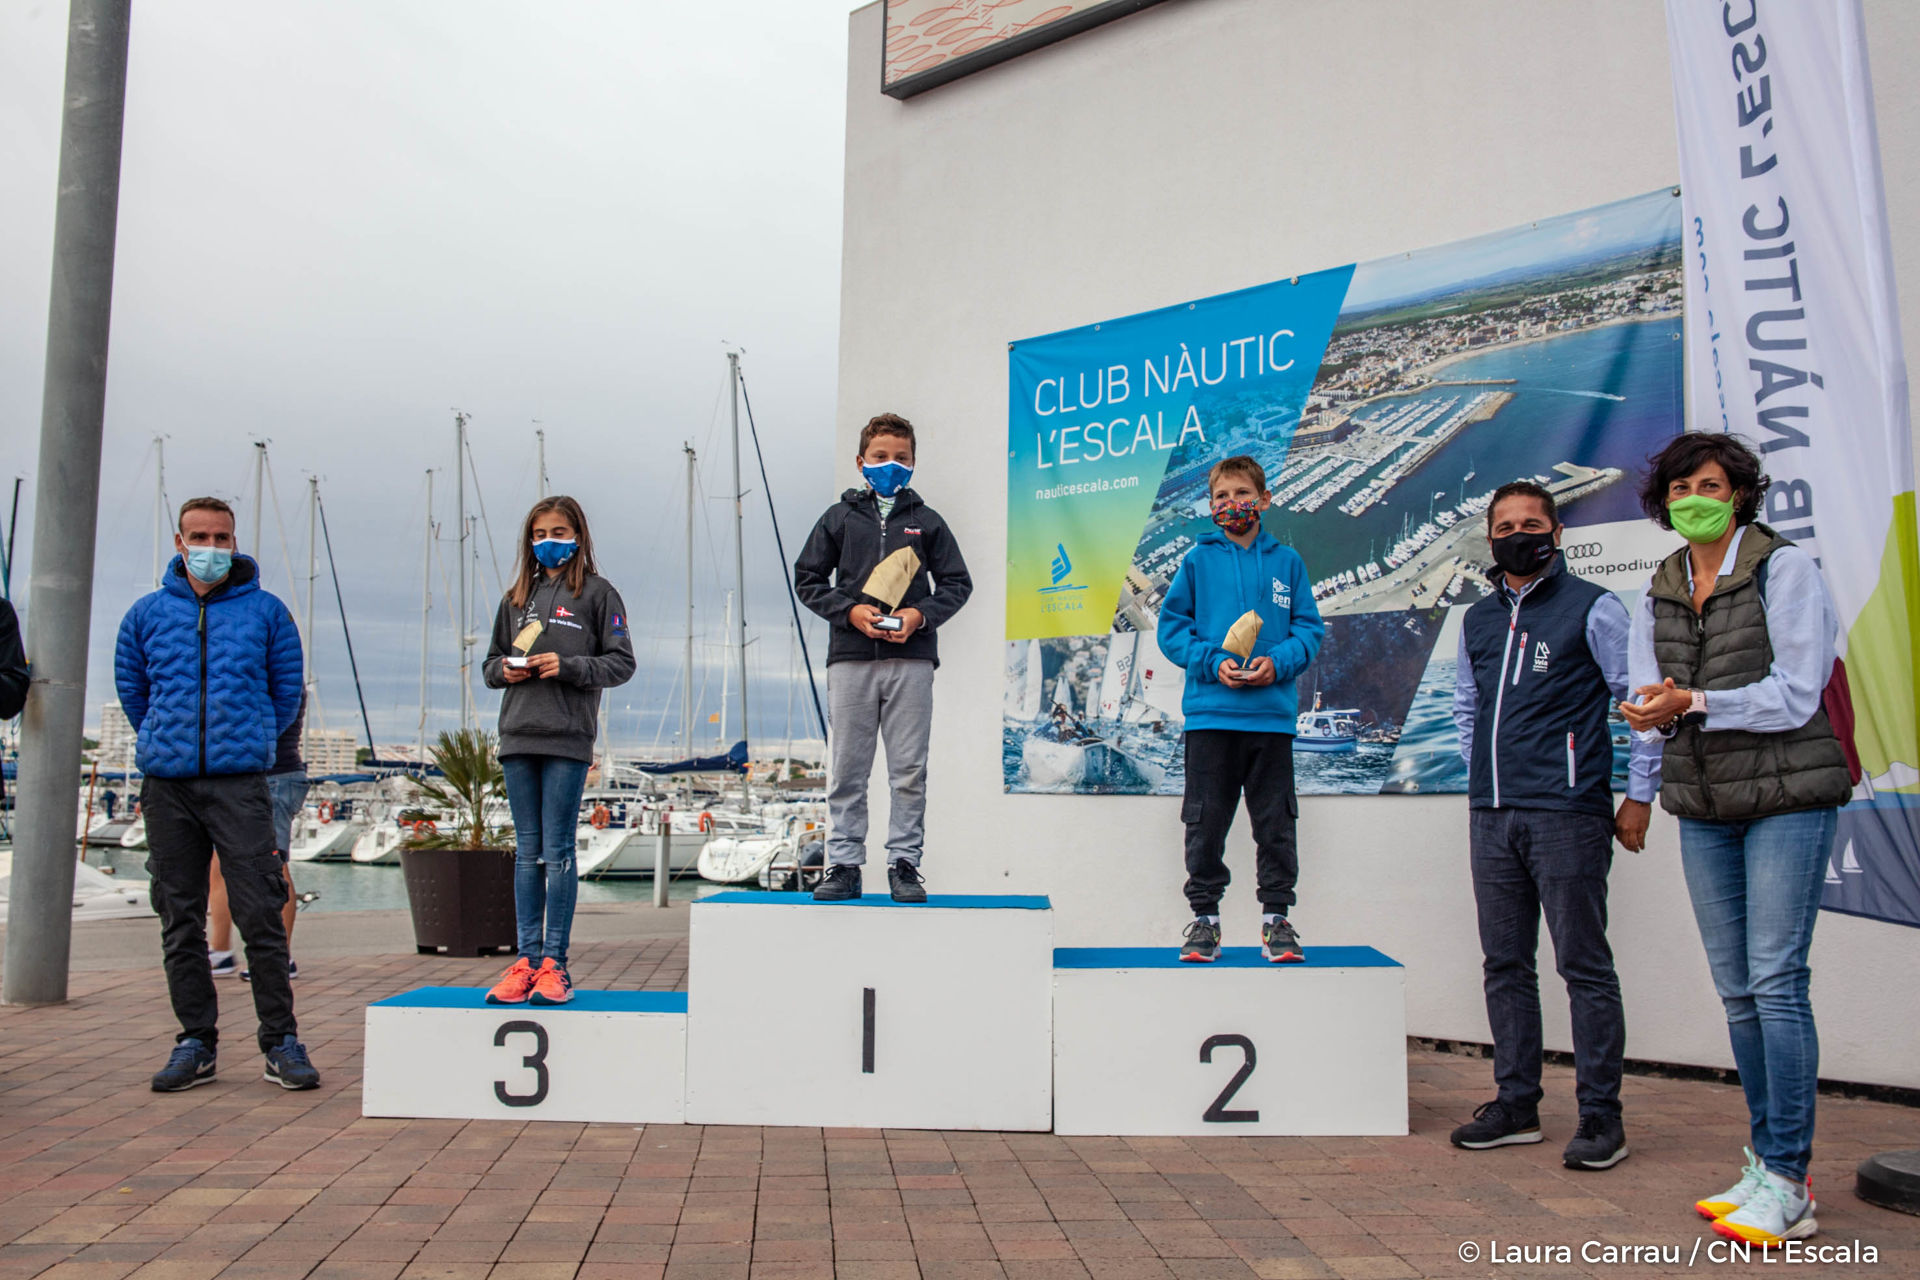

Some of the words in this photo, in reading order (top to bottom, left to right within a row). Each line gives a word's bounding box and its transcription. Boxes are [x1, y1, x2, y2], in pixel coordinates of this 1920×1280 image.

[1034, 364, 1130, 417] CLUB
[1144, 329, 1295, 397] NÀUTIC
[1037, 405, 1206, 469] L'ESCALA
[1035, 474, 1139, 500] nauticescala.com
[494, 1020, 548, 1106] 3
[1200, 1034, 1260, 1122] 2
